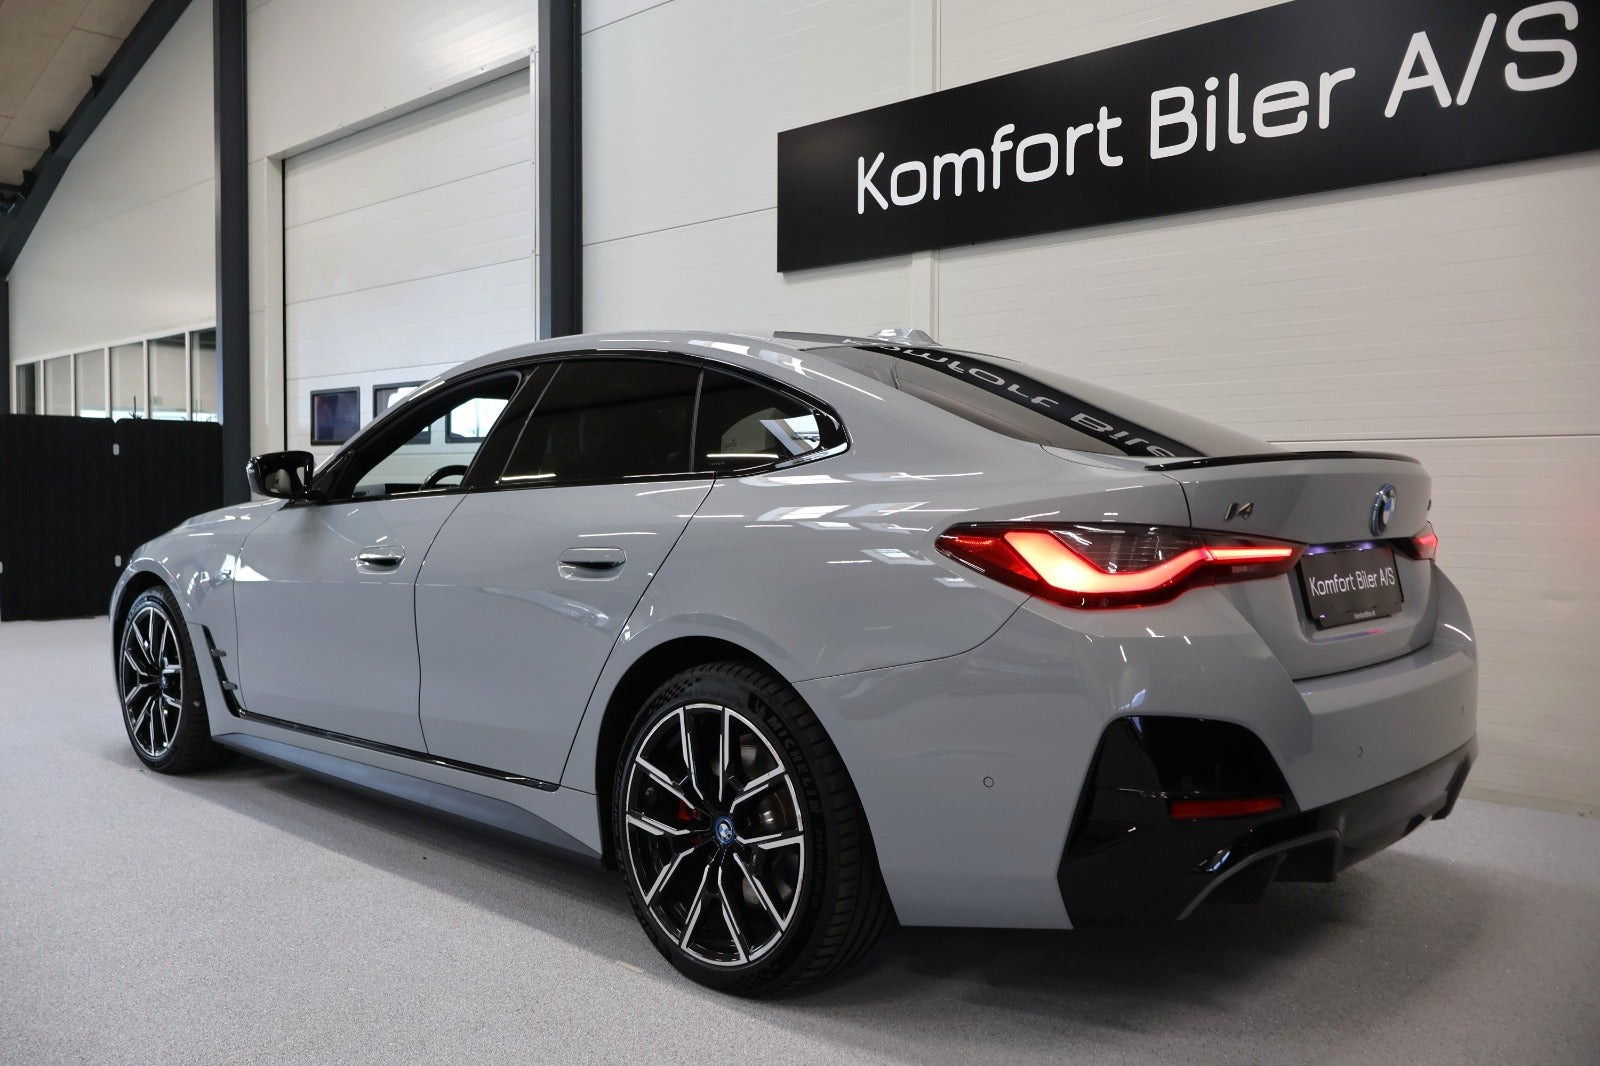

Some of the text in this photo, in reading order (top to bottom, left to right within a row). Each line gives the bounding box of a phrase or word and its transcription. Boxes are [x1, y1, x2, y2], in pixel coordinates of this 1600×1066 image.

[857, 0, 1579, 215] Komfort Biler A/S
[1308, 567, 1396, 597] Komfort Biler A/S
[767, 714, 822, 816] MICHELIN
